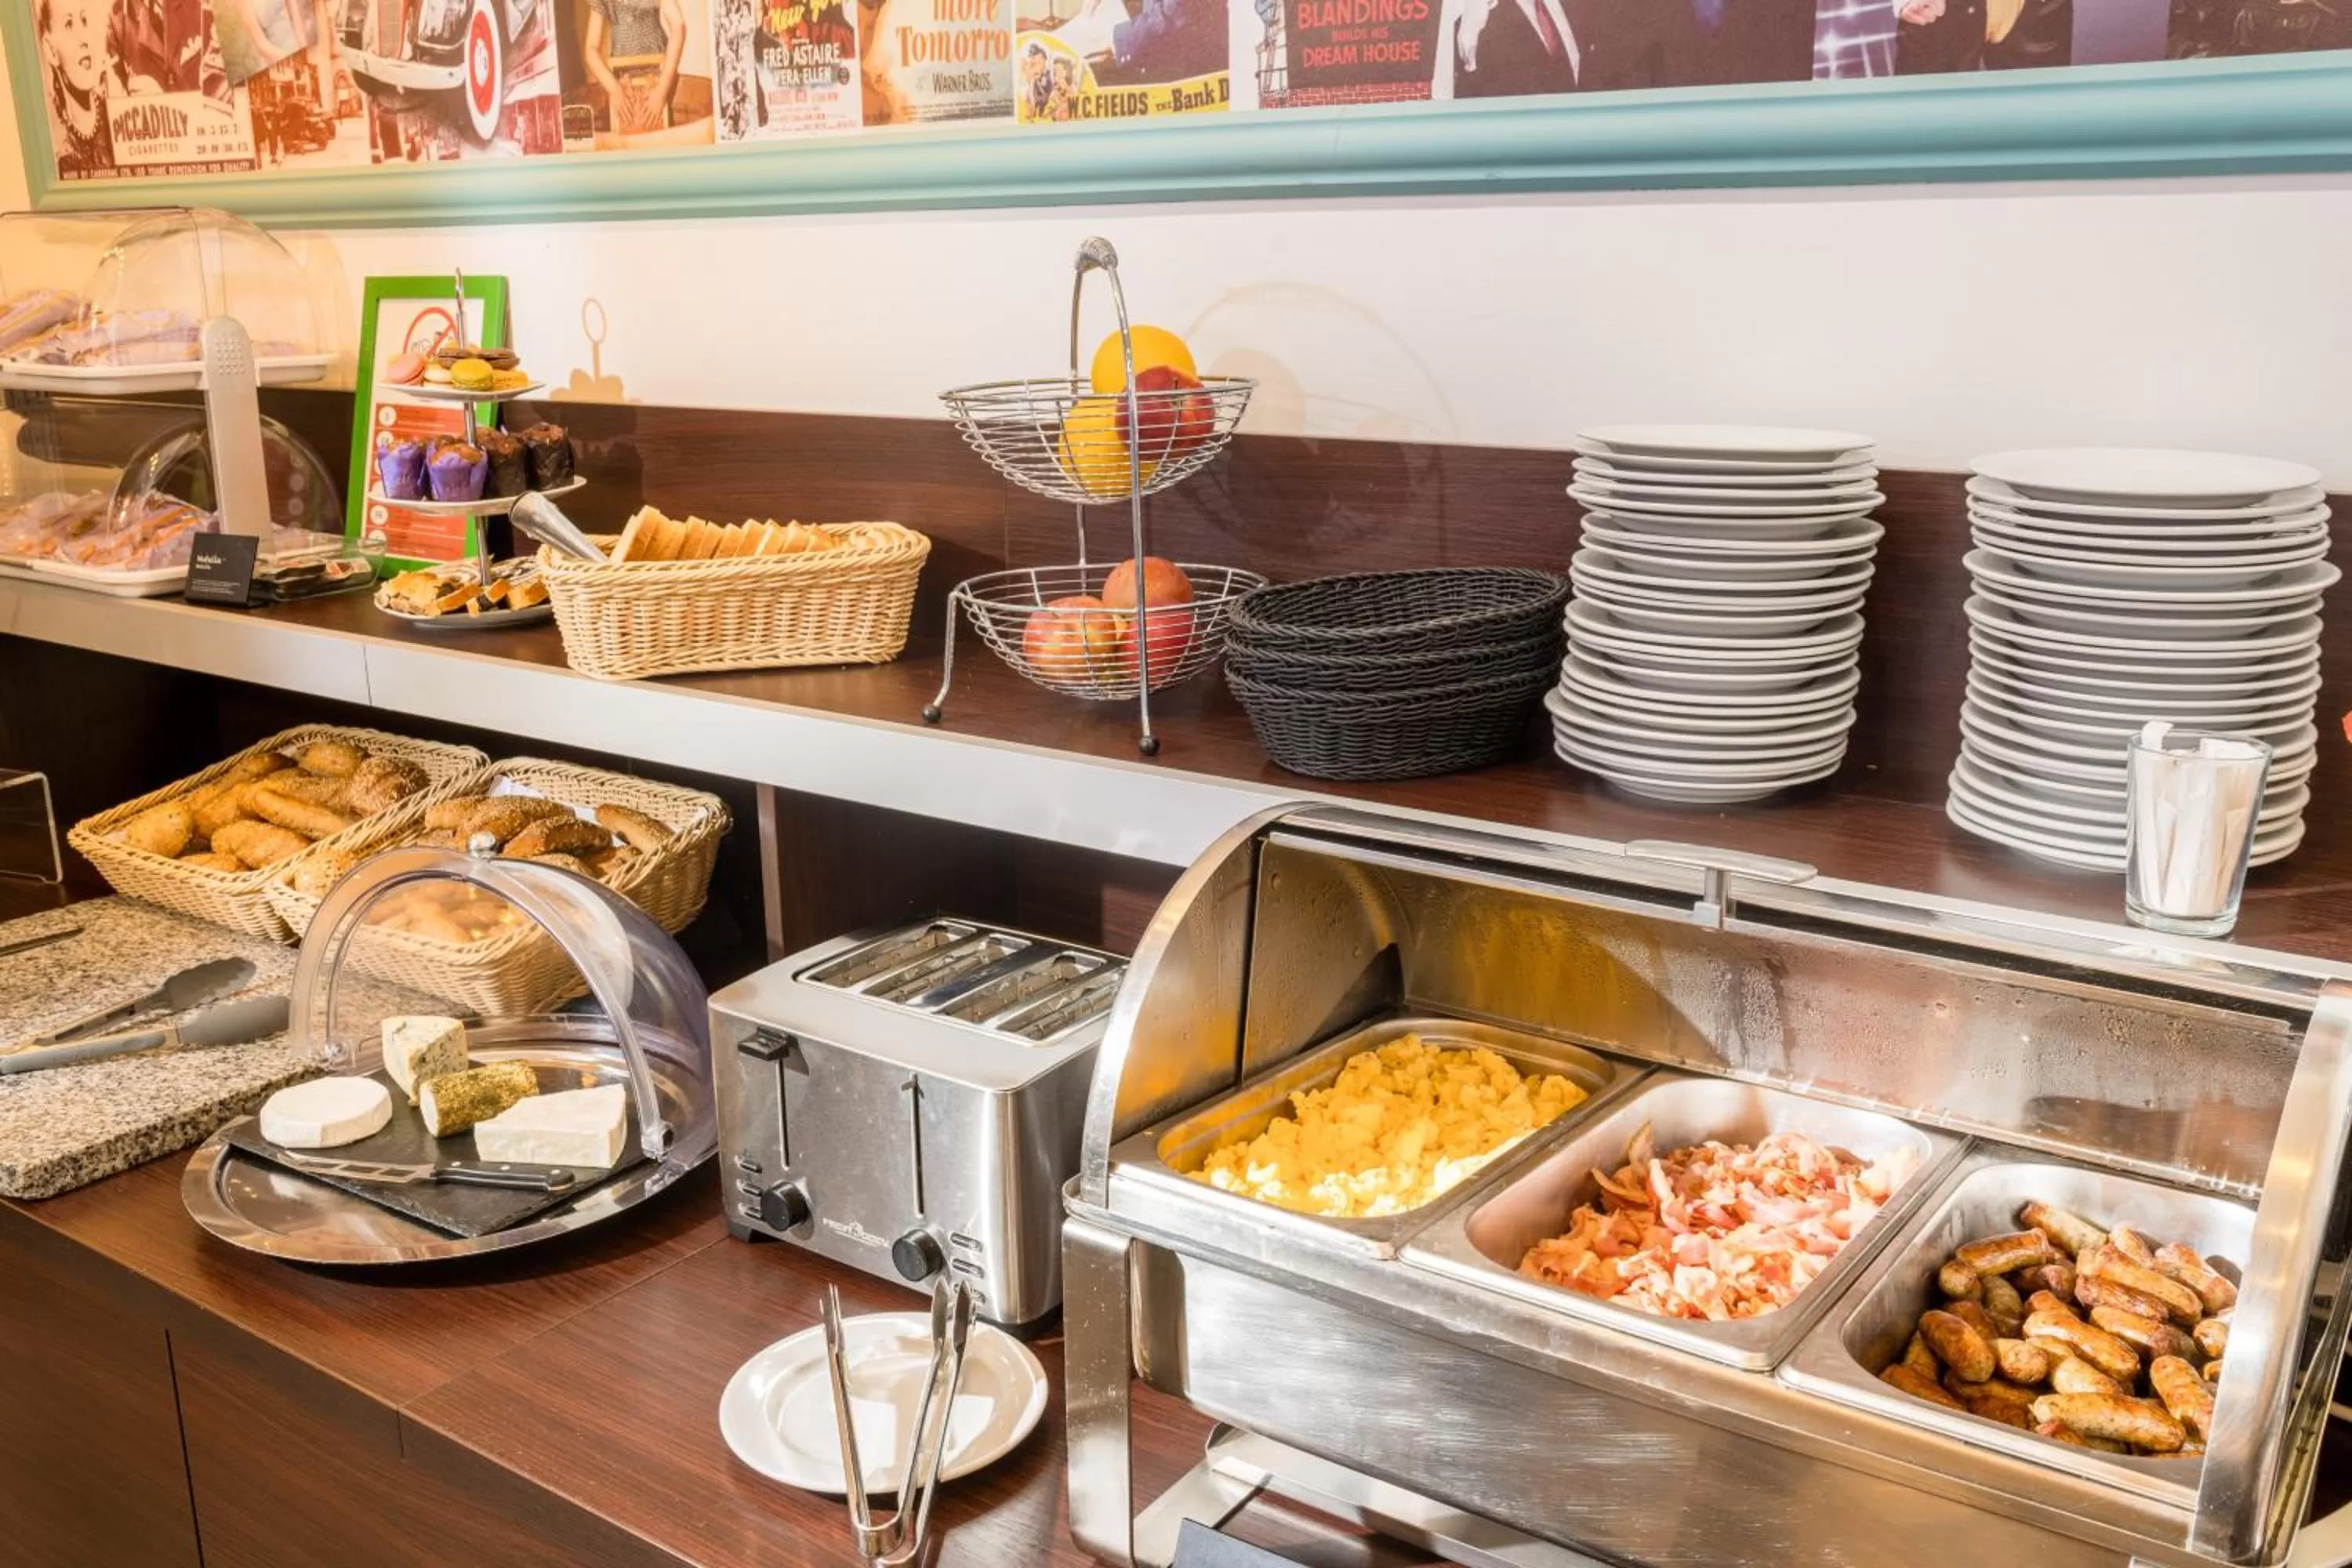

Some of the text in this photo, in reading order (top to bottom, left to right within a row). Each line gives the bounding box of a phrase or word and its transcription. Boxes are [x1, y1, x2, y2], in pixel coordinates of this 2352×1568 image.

[1298, 0, 1429, 29] BLANDINGS
[763, 42, 840, 67] FRED ASTAIRE
[895, 25, 1010, 67] Tomorro
[1303, 40, 1421, 67] DREAM HOUSE
[932, 71, 967, 95] WARNER
[1171, 82, 1215, 112] Bank
[1218, 78, 1229, 102] D
[113, 103, 189, 143] PICCADILLY
